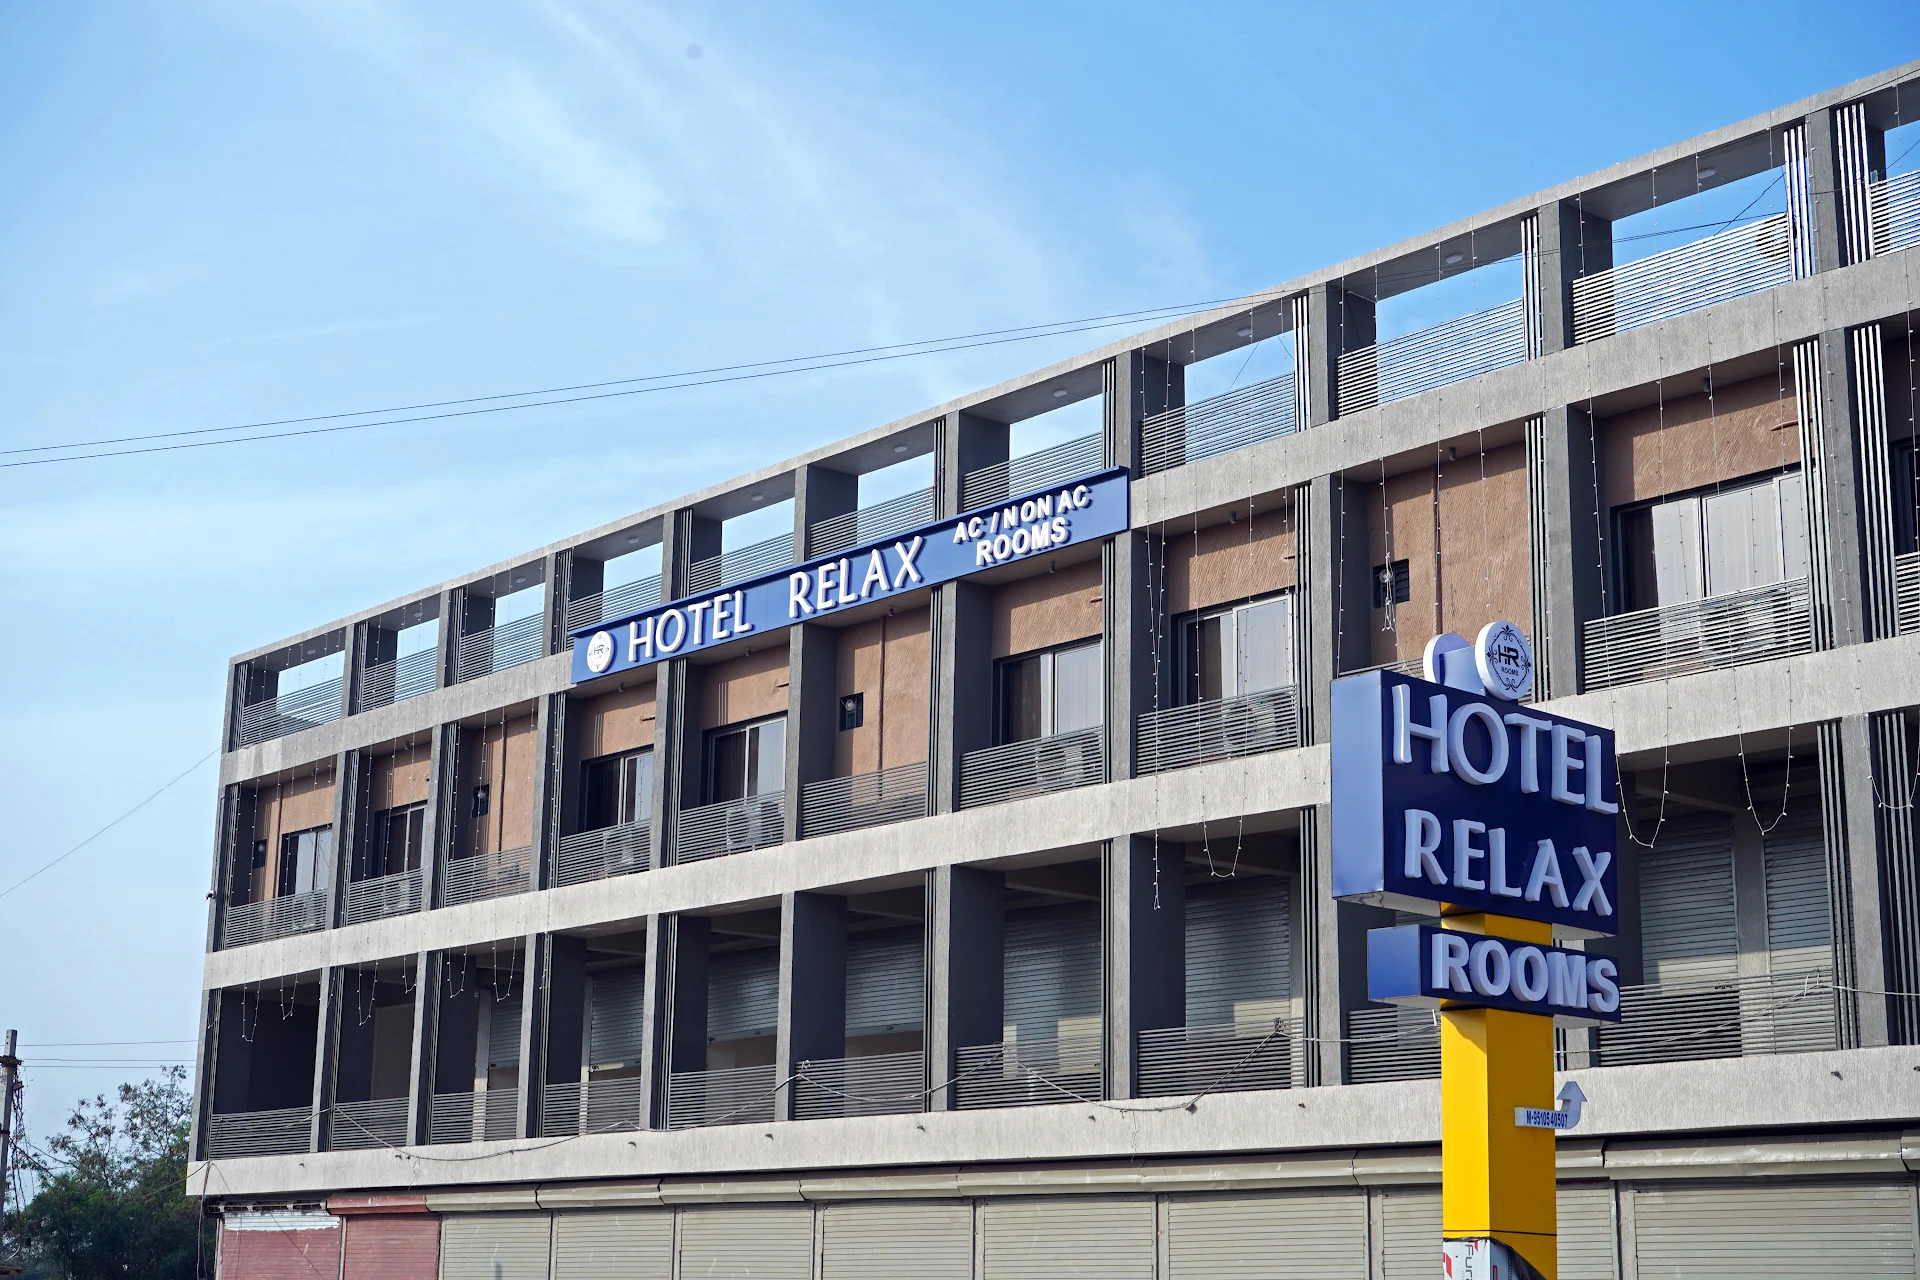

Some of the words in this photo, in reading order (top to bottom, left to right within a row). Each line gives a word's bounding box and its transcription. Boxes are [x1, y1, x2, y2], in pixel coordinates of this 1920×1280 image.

[953, 516, 984, 543] AC
[1003, 494, 1053, 529] NON
[1057, 484, 1089, 513] AC
[976, 517, 1069, 566] ROOMS
[628, 589, 754, 662] HOTEL
[788, 535, 924, 618] RELAX
[1497, 644, 1520, 668] HR
[1501, 666, 1519, 677] ROOMS
[1391, 683, 1619, 815] HOTEL
[1404, 808, 1613, 916] RELAX
[1431, 932, 1620, 1013] ROOMS
